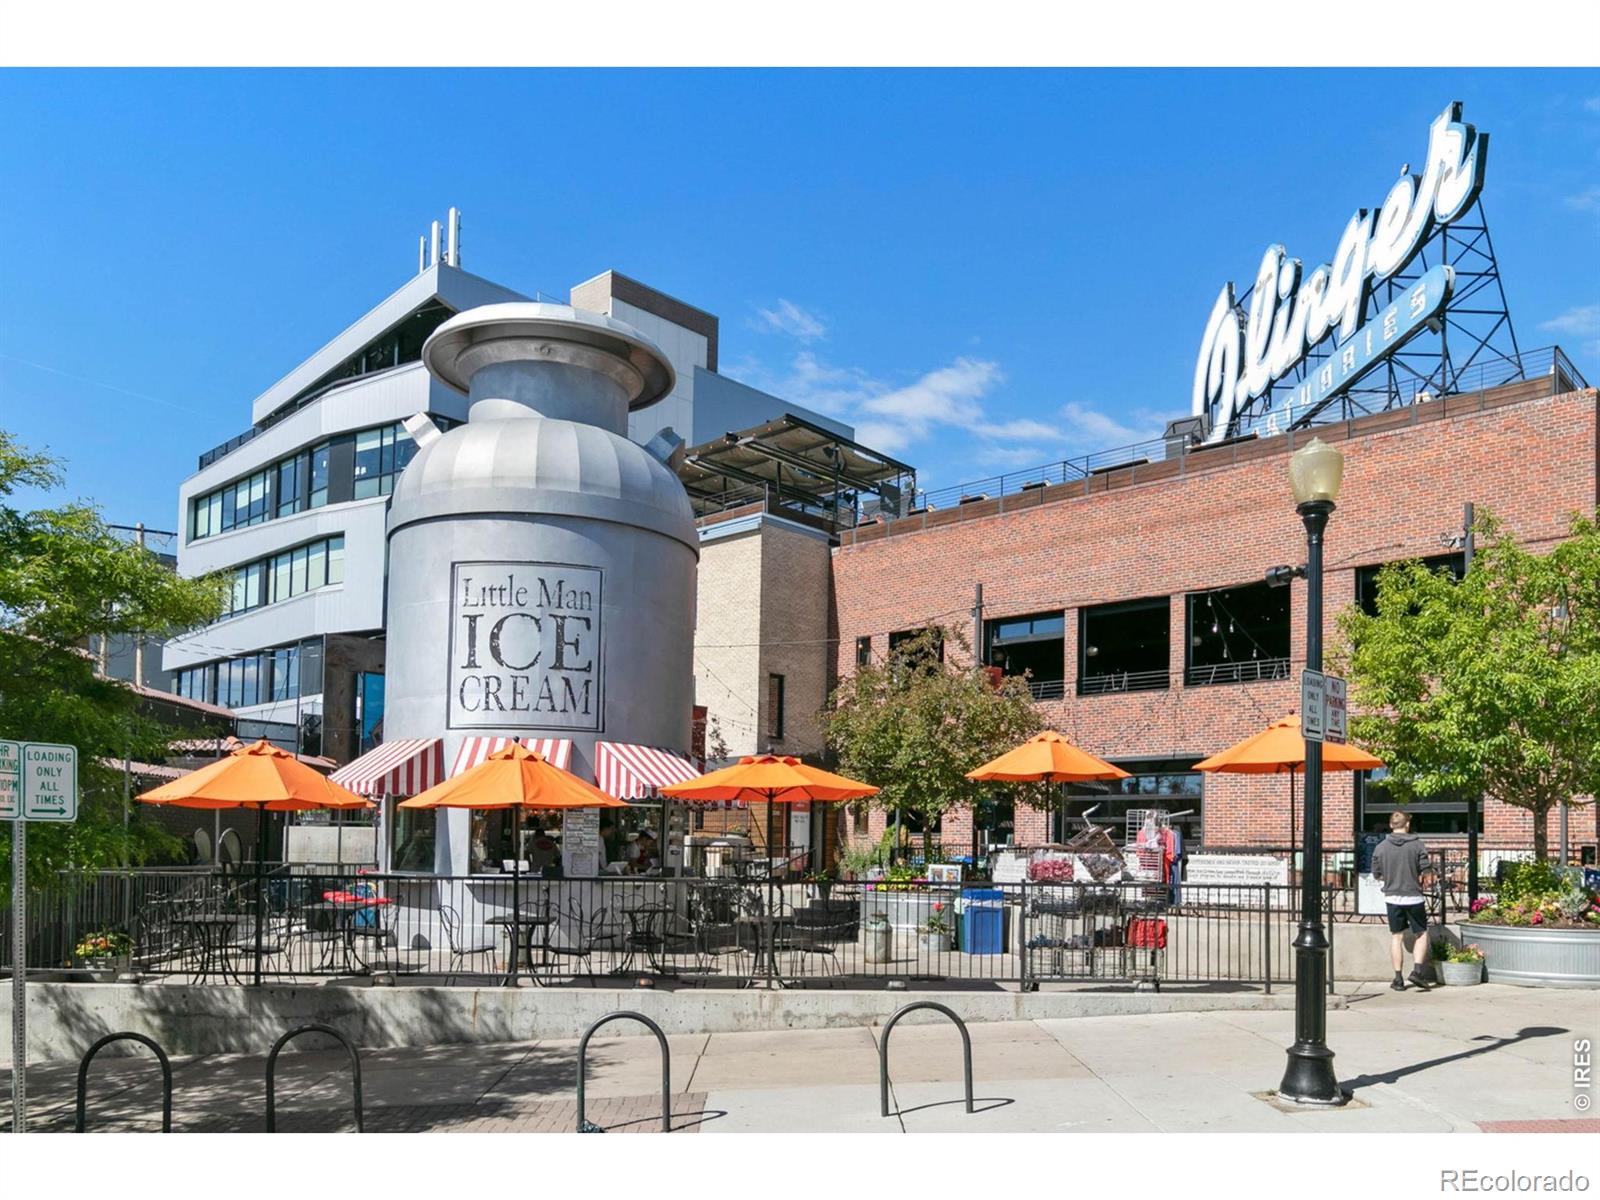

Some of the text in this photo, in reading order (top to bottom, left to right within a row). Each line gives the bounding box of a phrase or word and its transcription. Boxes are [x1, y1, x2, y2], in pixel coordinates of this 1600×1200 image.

[463, 574, 593, 610] Little Man
[461, 613, 592, 672] ICE
[459, 675, 592, 714] CREAM
[27, 751, 71, 763] LOADING
[36, 767, 63, 777] ONLY
[40, 781, 60, 791] ALL
[35, 794, 65, 805] TIMES
